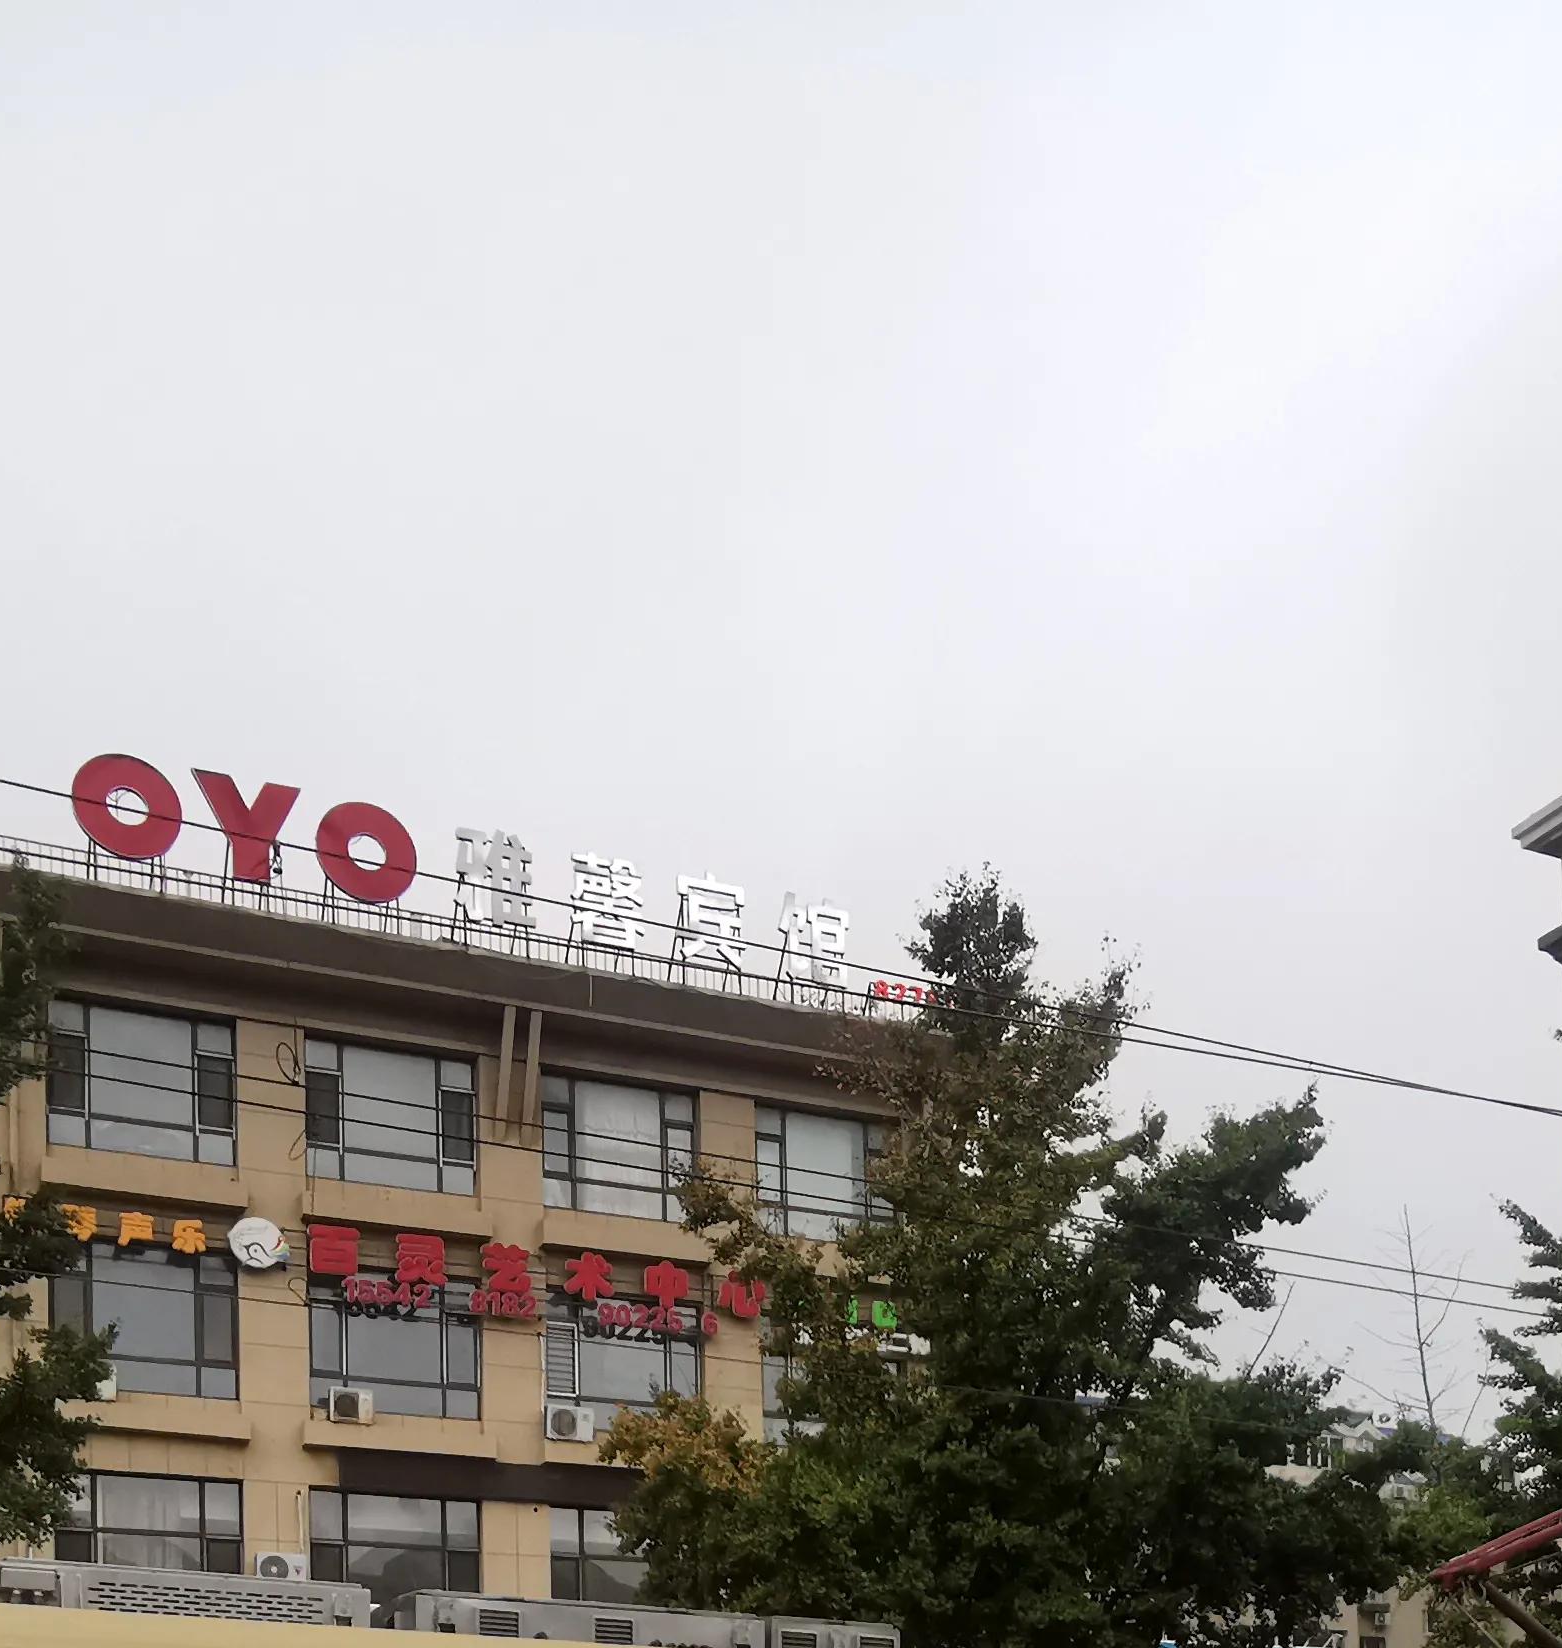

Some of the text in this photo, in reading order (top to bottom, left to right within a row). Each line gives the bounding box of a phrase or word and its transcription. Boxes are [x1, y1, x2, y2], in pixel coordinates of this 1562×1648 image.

[71, 752, 418, 905] OYO
[453, 826, 851, 989] 雅馨宾馆
[3, 1196, 207, 1254] 琴声乐
[305, 1223, 768, 1319] 百灵艺术中心
